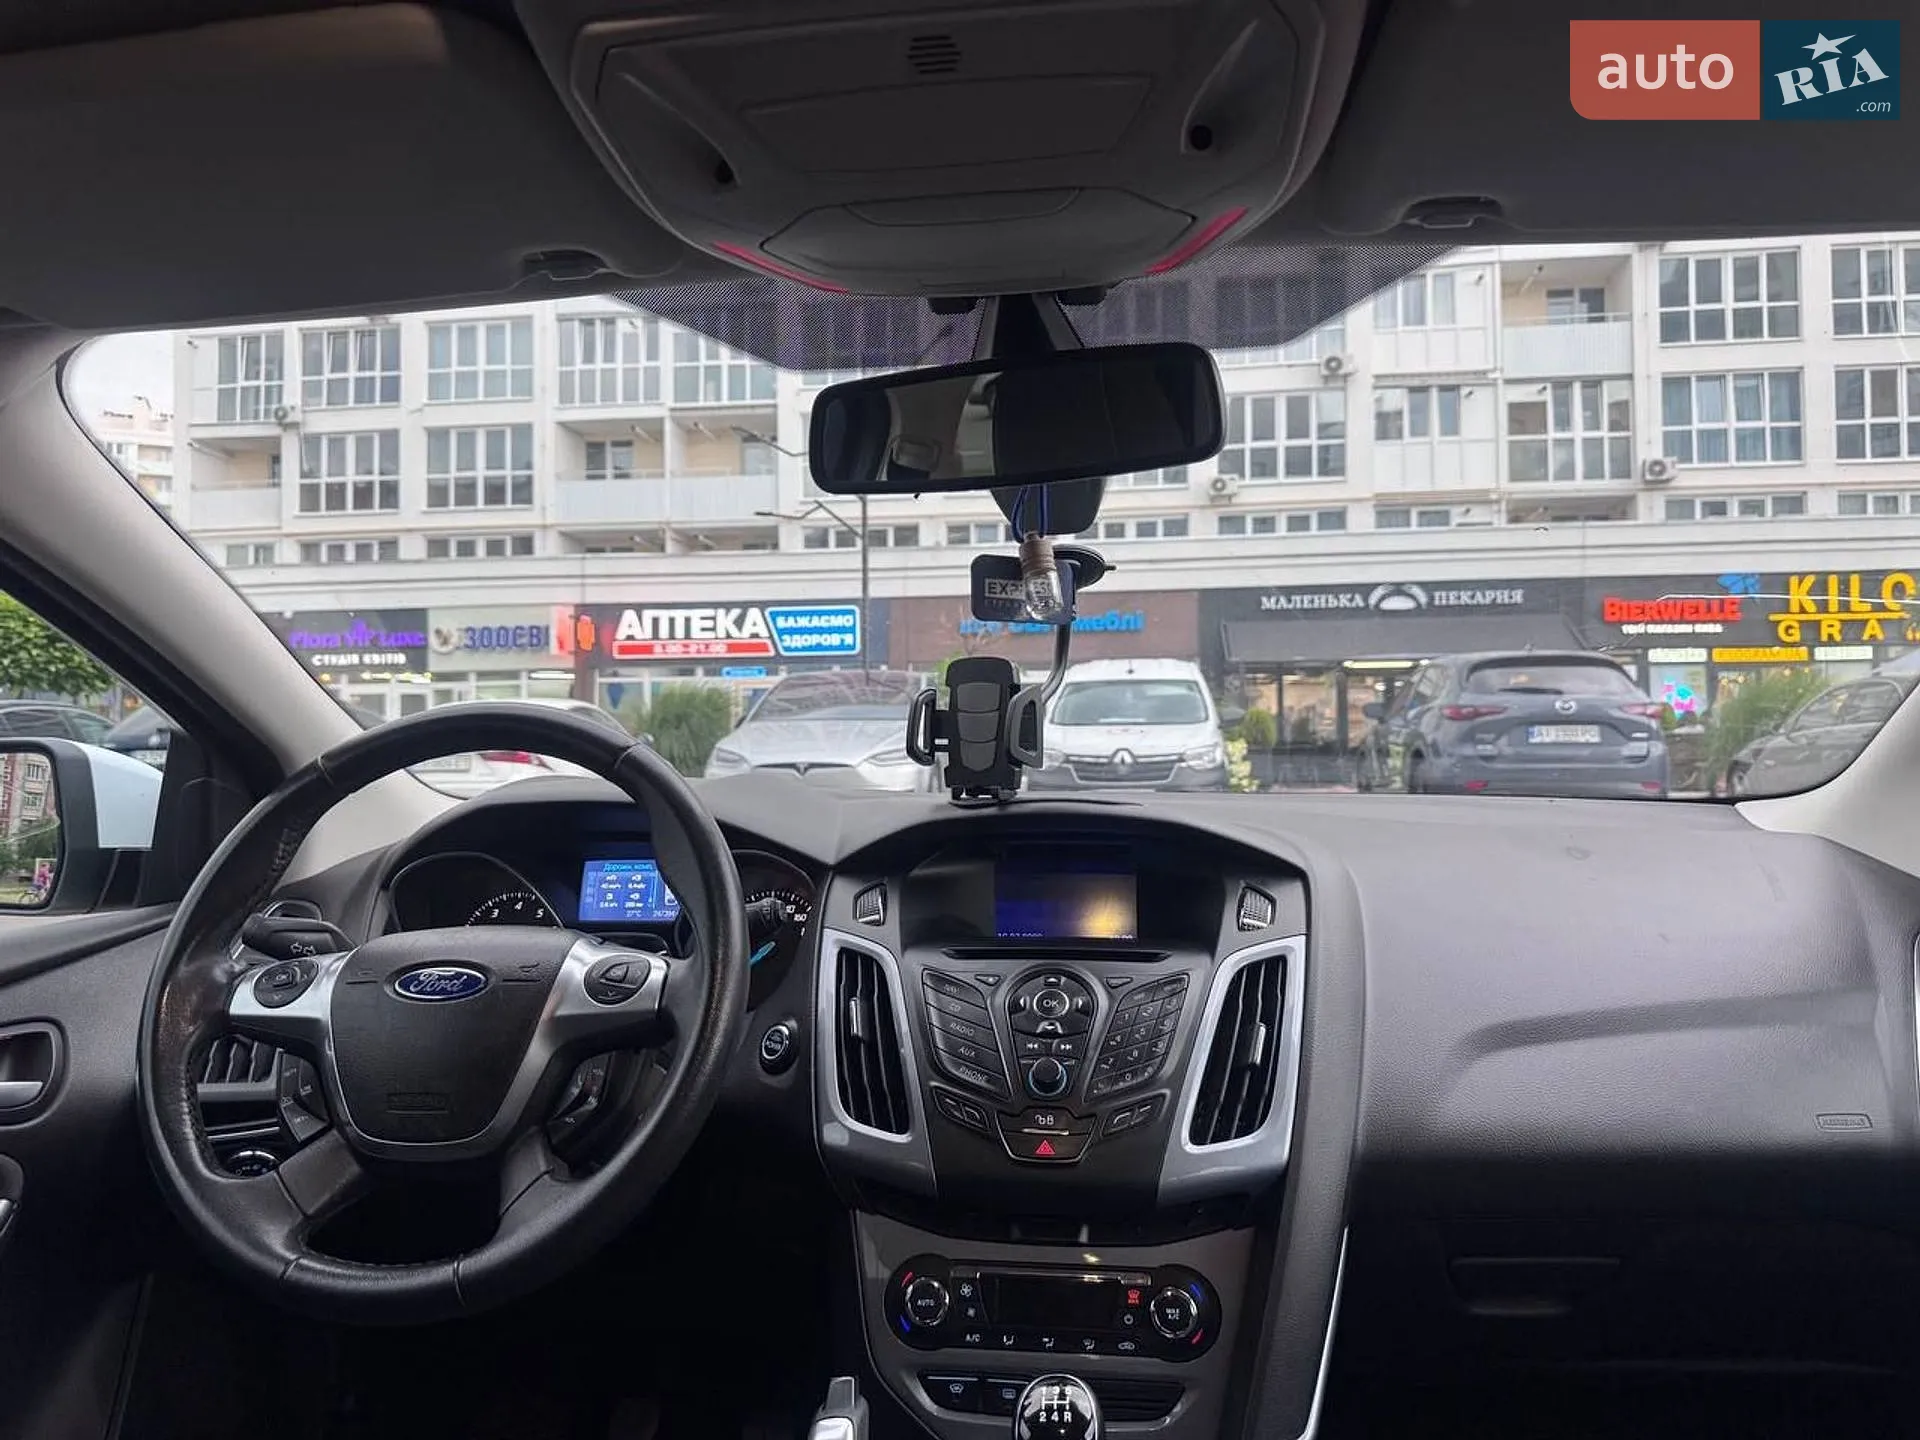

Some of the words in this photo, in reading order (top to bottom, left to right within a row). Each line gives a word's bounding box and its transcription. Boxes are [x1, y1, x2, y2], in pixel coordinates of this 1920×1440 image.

[1260, 592, 1365, 610] МАЛЕНЬКА
[1434, 589, 1524, 606] ПЕКАРНЯ
[1789, 572, 1917, 613] KILO
[615, 607, 770, 641] АПТЕКА
[1778, 619, 1920, 643] GRA
[490, 909, 500, 918] 3
[514, 901, 523, 910] 4
[535, 908, 544, 918] 5
[410, 971, 467, 992] Ford
[1042, 999, 1059, 1008] OK
[950, 1022, 974, 1036] RADIO
[959, 1046, 975, 1058] AUX
[959, 1066, 988, 1083] PHONE
[965, 1333, 981, 1343] A/C
[1039, 1411, 1046, 1422] 2
[1051, 1411, 1059, 1422] 4
[1064, 1411, 1072, 1422] R
